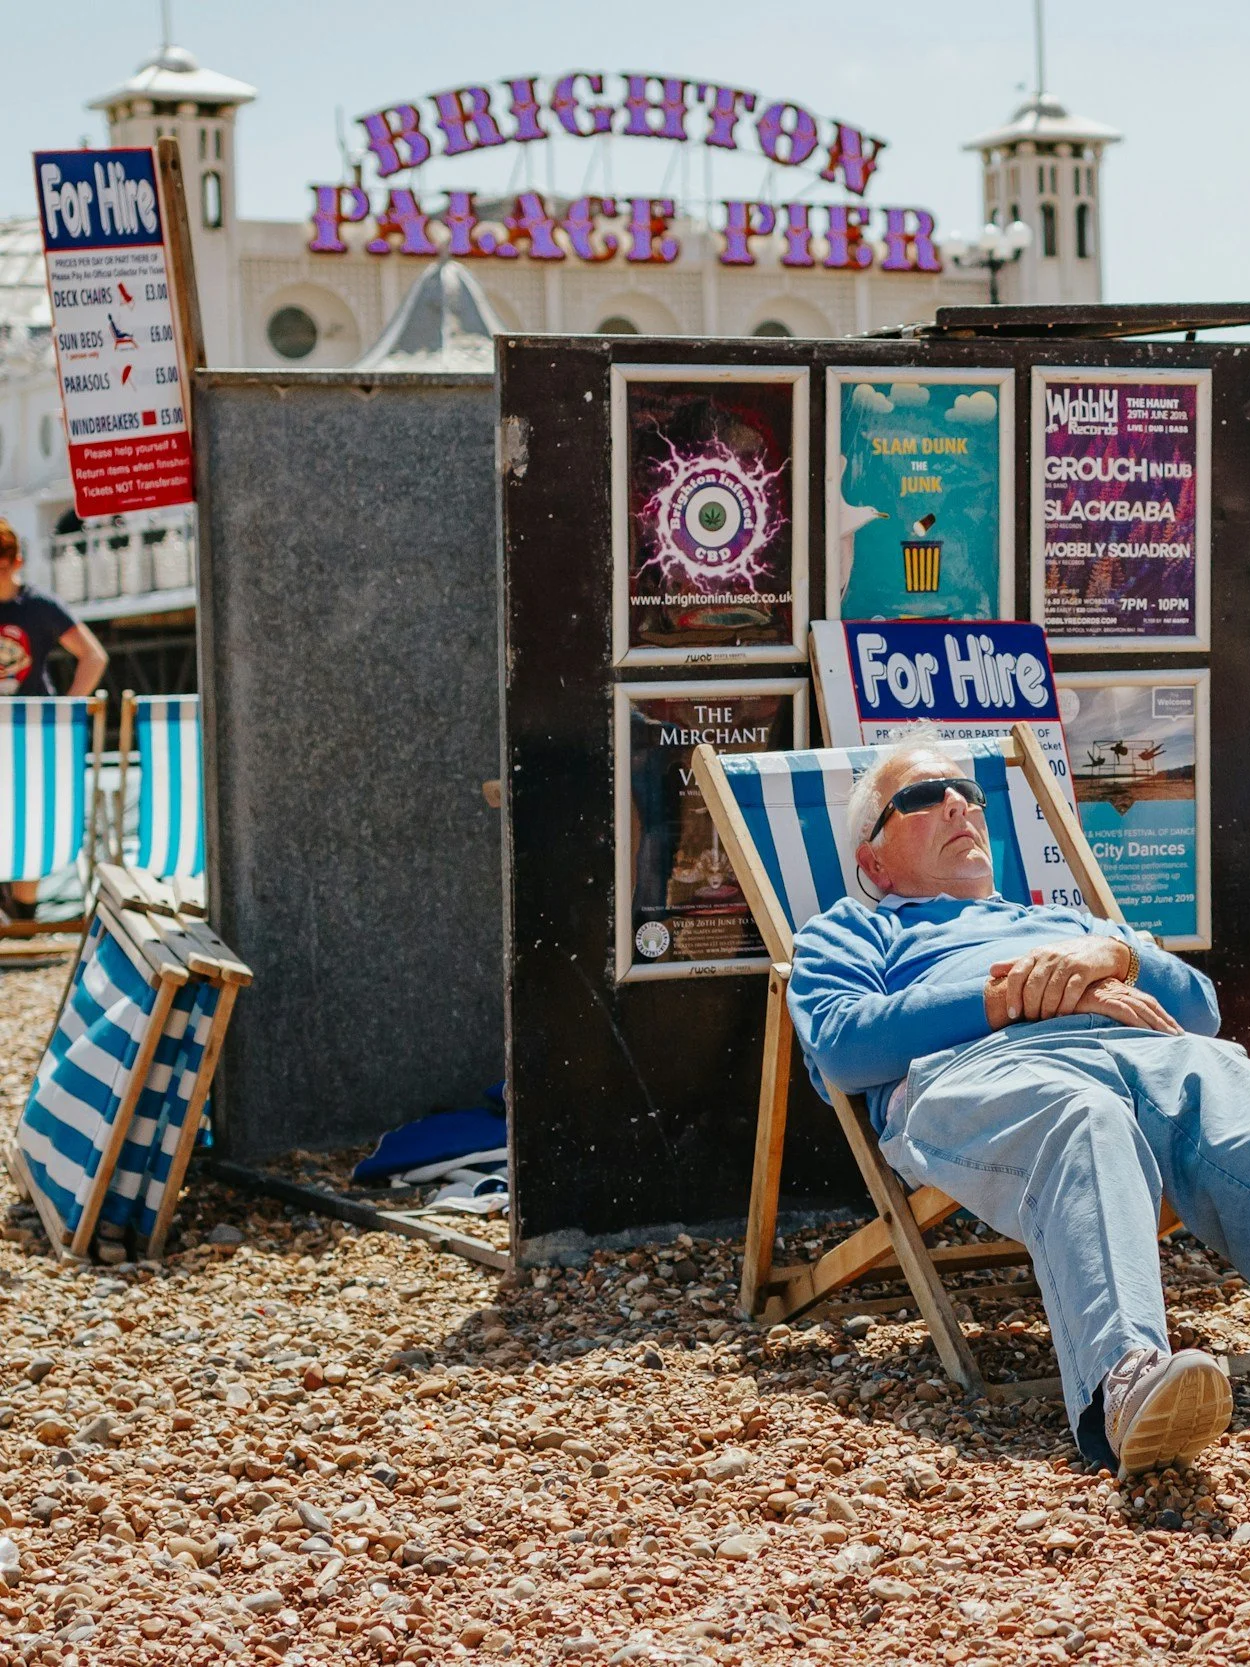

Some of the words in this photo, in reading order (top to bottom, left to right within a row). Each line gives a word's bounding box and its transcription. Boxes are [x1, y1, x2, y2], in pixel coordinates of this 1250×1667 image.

[356, 72, 887, 196] BRIGHTON
[41, 163, 93, 239] For
[94, 161, 158, 236] Hire
[308, 186, 680, 264] PALACE
[718, 201, 943, 272] PIER
[54, 290, 78, 308] DECK
[80, 286, 113, 306] CHAIRS
[145, 283, 168, 301] £3.00
[59, 333, 78, 351] SUN
[80, 330, 104, 349] BEDS
[150, 326, 173, 342] £6.00
[64, 372, 110, 394] PARASOLS
[155, 366, 178, 385] £5.00
[1046, 388, 1119, 426] Wobbly
[1126, 398, 1145, 409] THE
[1146, 398, 1180, 410] HAUNT
[70, 412, 140, 436] WINDBREAKERS
[161, 406, 184, 426] £5.00
[1127, 410, 1148, 420] 29TH
[1150, 410, 1169, 420] JUNE
[1068, 421, 1119, 436] Records
[1127, 424, 1144, 432] LIVE
[1148, 424, 1164, 433] DUB
[1169, 425, 1188, 433] BASS
[84, 448, 112, 460] Please
[114, 444, 133, 457] help
[136, 440, 169, 456] yourself
[872, 438, 916, 455] SLAM
[922, 437, 968, 454] DUNK
[76, 468, 106, 480] Return
[107, 464, 131, 476] items
[133, 462, 155, 473] when
[911, 461, 928, 471] THE
[1045, 456, 1148, 482] GROUCH
[1150, 462, 1164, 478] IN
[1164, 463, 1192, 478] DUB
[82, 486, 114, 498] Tickets
[116, 480, 134, 493] NOT
[900, 476, 943, 497] JUNK
[670, 474, 717, 530] Brighton
[1045, 500, 1176, 522] SLACKBABA
[694, 546, 732, 562] CBD
[1108, 542, 1191, 558] SQUADRON
[630, 590, 793, 608] www.brightoninfused.co.uk
[1120, 598, 1148, 611] 7PM
[1158, 598, 1190, 611] 10PM
[856, 632, 939, 709] For
[944, 633, 1050, 709] Hire
[694, 706, 733, 724] THE
[660, 727, 769, 746] MERCHANT
[958, 729, 973, 738] OR
[975, 729, 1000, 738] PART
[1038, 728, 1050, 738] OF
[1040, 742, 1062, 751] icket
[1095, 830, 1122, 838] HOVE'S
[1124, 828, 1156, 836] FESTIVAL
[1158, 828, 1169, 836] OF
[1092, 842, 1124, 860] City
[1128, 842, 1186, 857] Dances
[1116, 896, 1140, 906] unday
[1140, 895, 1152, 904] 30
[1154, 895, 1174, 904] June
[1174, 894, 1194, 903] 2019
